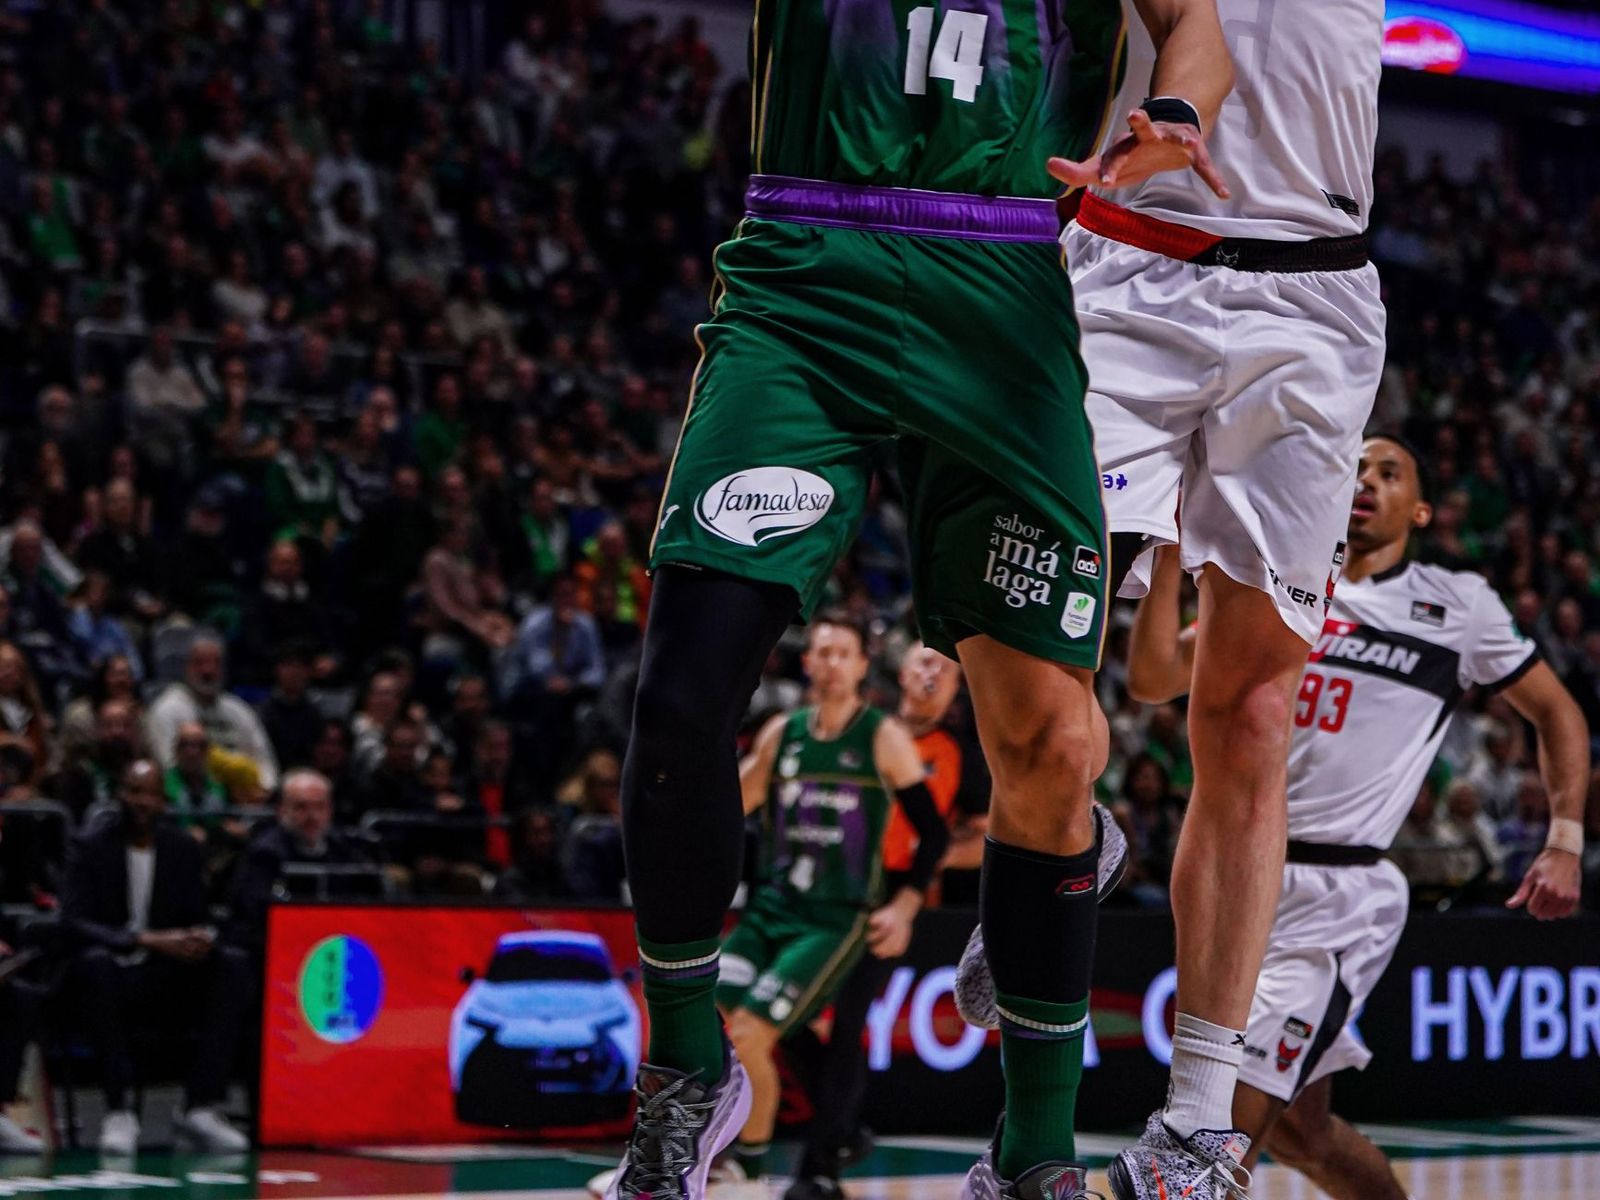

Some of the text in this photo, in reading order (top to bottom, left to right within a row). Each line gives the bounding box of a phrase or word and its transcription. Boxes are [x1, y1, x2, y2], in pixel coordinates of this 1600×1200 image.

[904, 6, 989, 103] 14
[709, 474, 830, 520] famadesa
[994, 513, 1045, 542] sabor
[983, 550, 1053, 609] laga
[990, 532, 1062, 579] a má
[1294, 672, 1354, 734] 93
